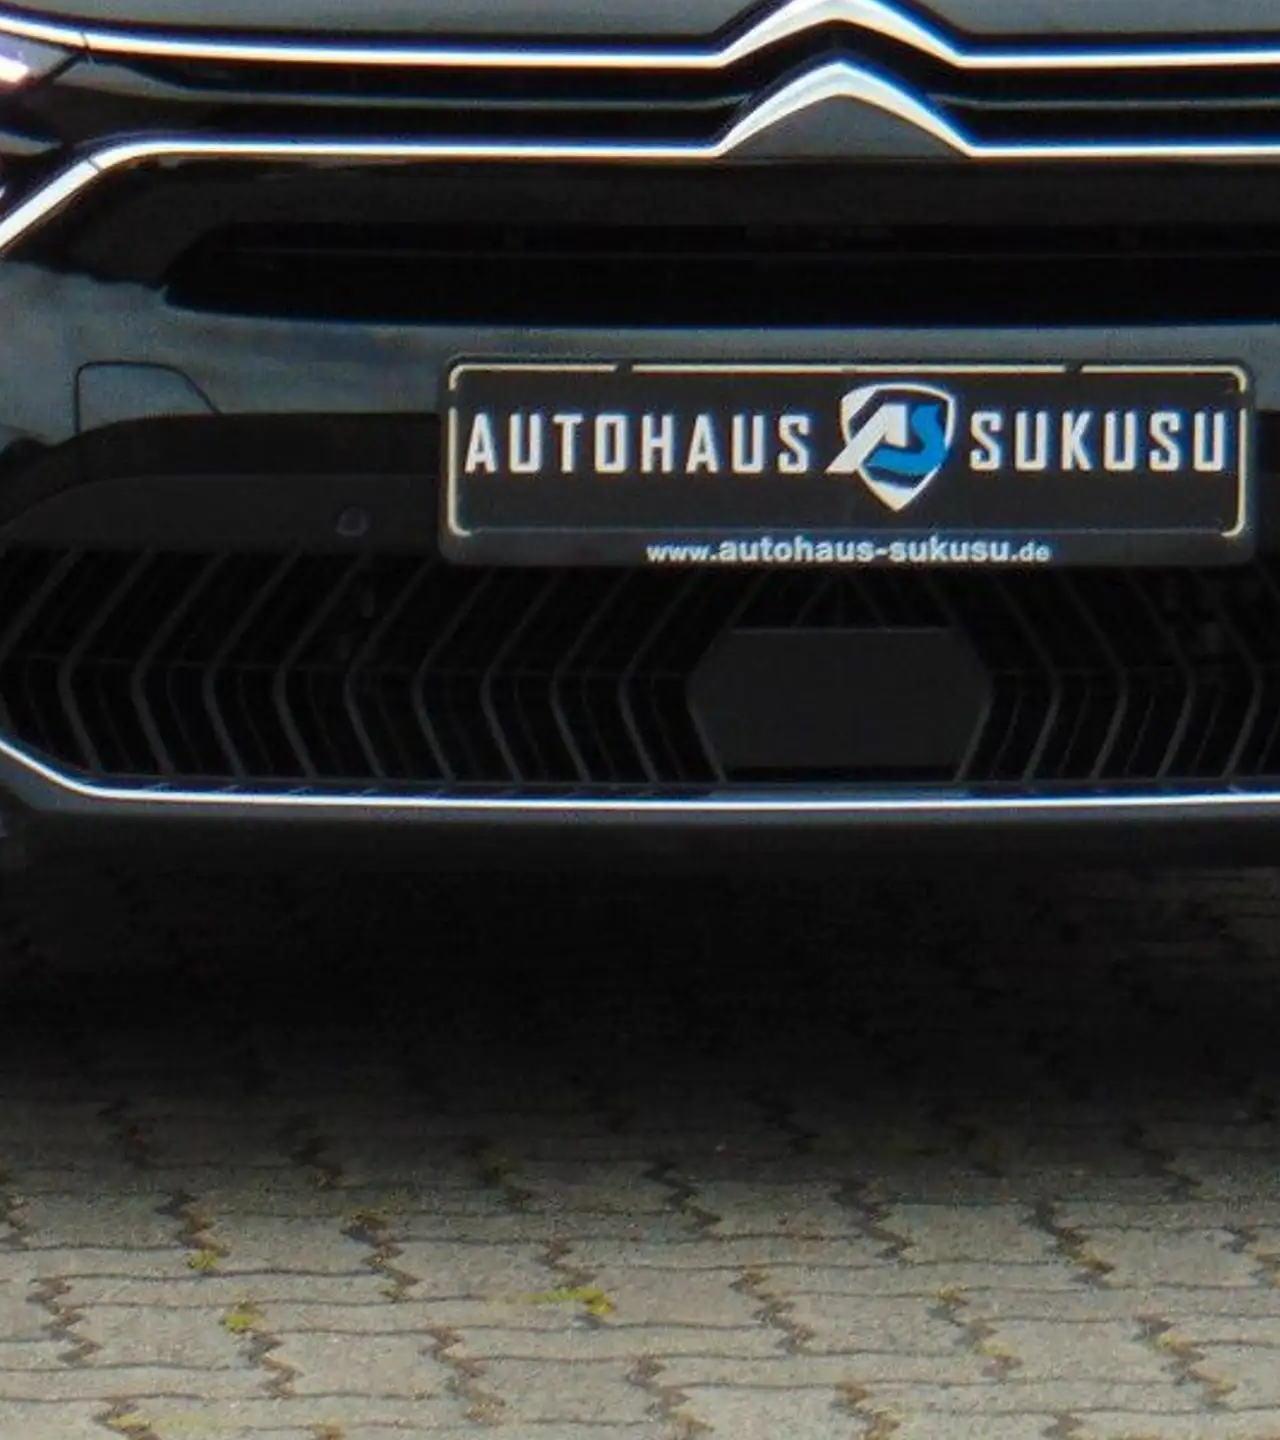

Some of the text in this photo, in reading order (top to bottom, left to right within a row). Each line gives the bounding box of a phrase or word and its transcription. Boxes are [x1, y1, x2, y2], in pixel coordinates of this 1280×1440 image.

[464, 412, 811, 474] AUTOHAUS
[969, 409, 1225, 472] SUKUSU
[646, 535, 1051, 563] www.autohaus-sukusu.de
